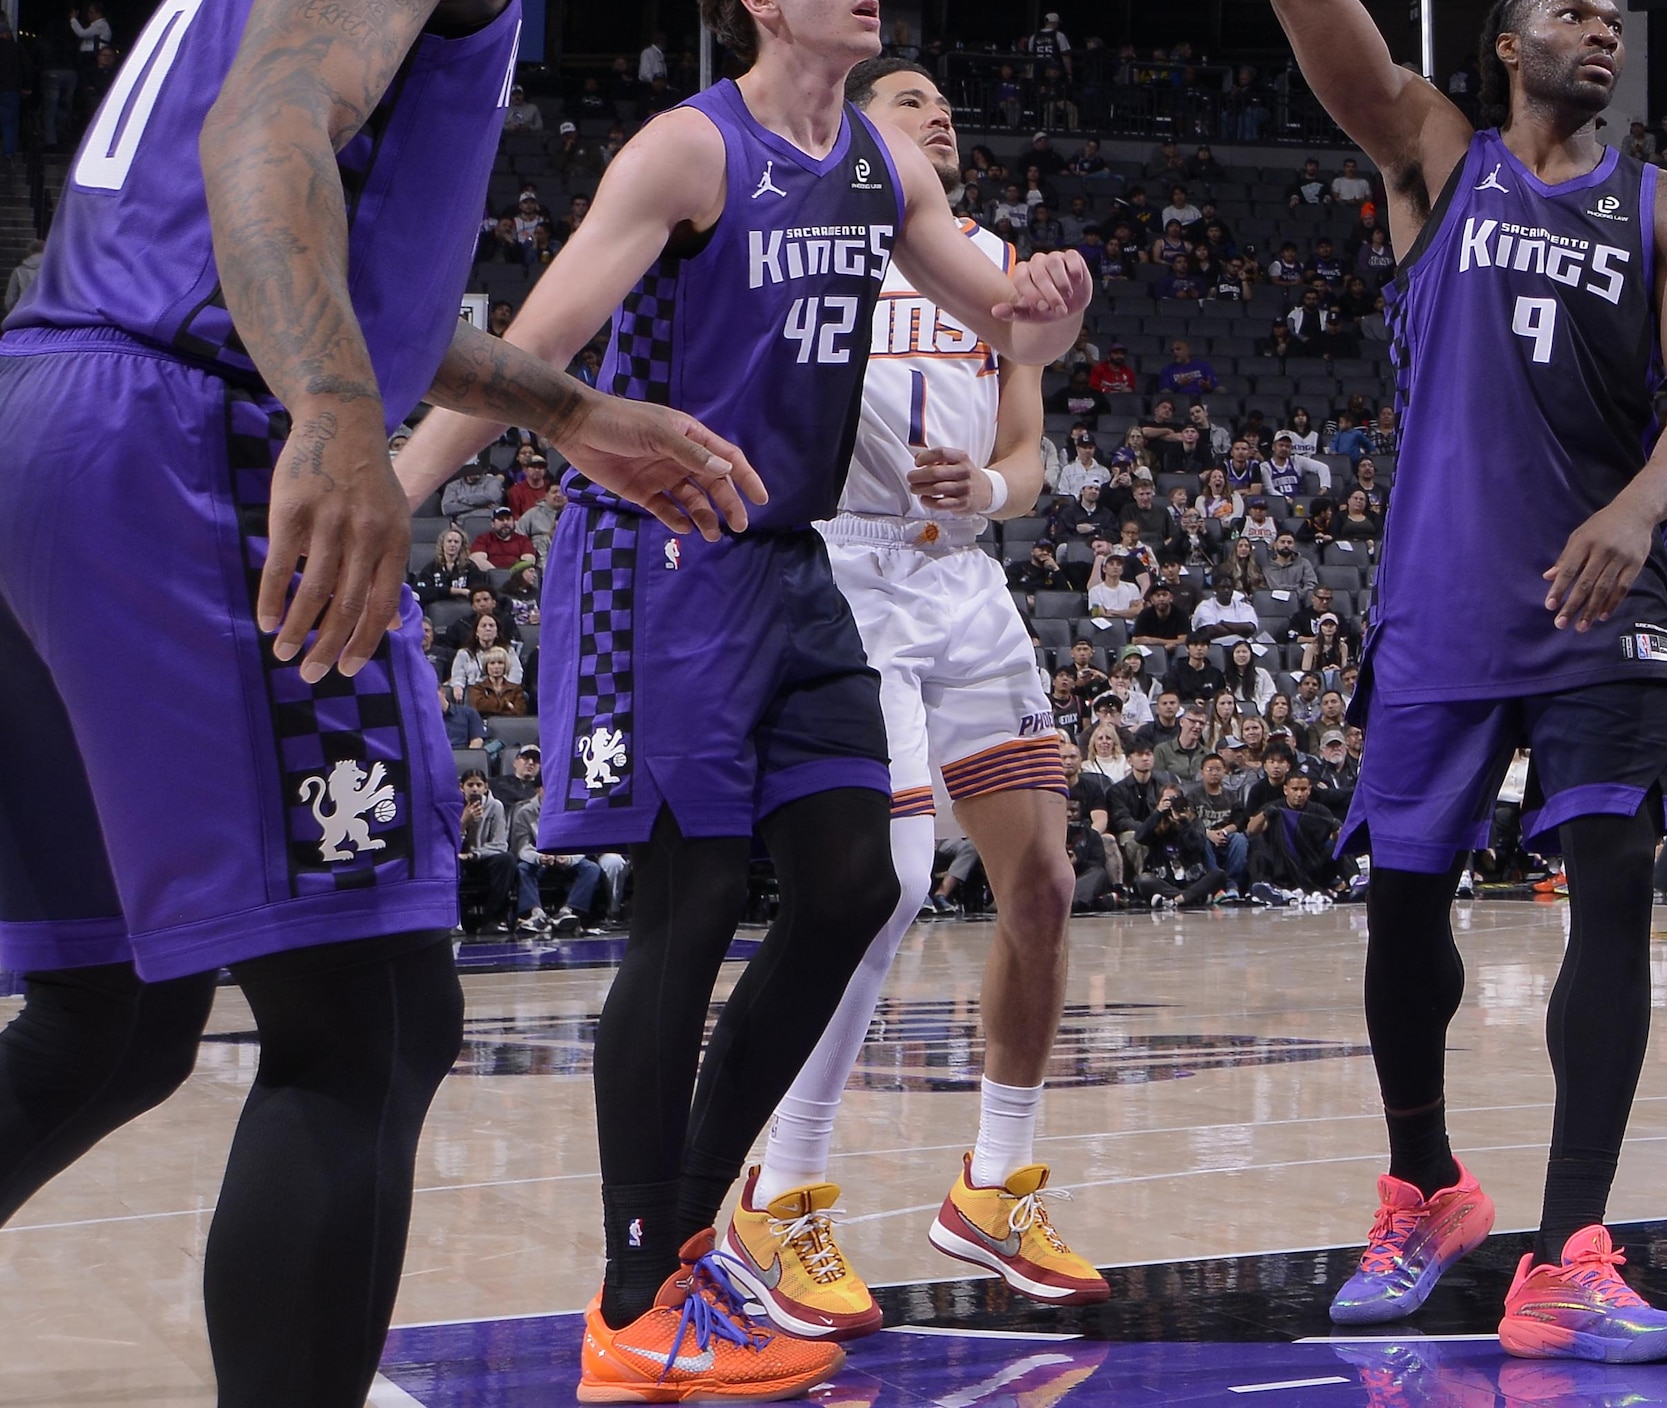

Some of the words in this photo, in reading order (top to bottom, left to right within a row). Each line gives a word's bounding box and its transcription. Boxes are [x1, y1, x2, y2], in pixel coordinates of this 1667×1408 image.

[749, 225, 893, 289] KINGS
[786, 225, 866, 238] SACRAMENTO
[1459, 217, 1630, 305] KINGS
[1501, 222, 1589, 250] SACRAMENTO
[784, 296, 858, 363] 42
[1512, 296, 1557, 363] 9
[907, 368, 928, 448] 1
